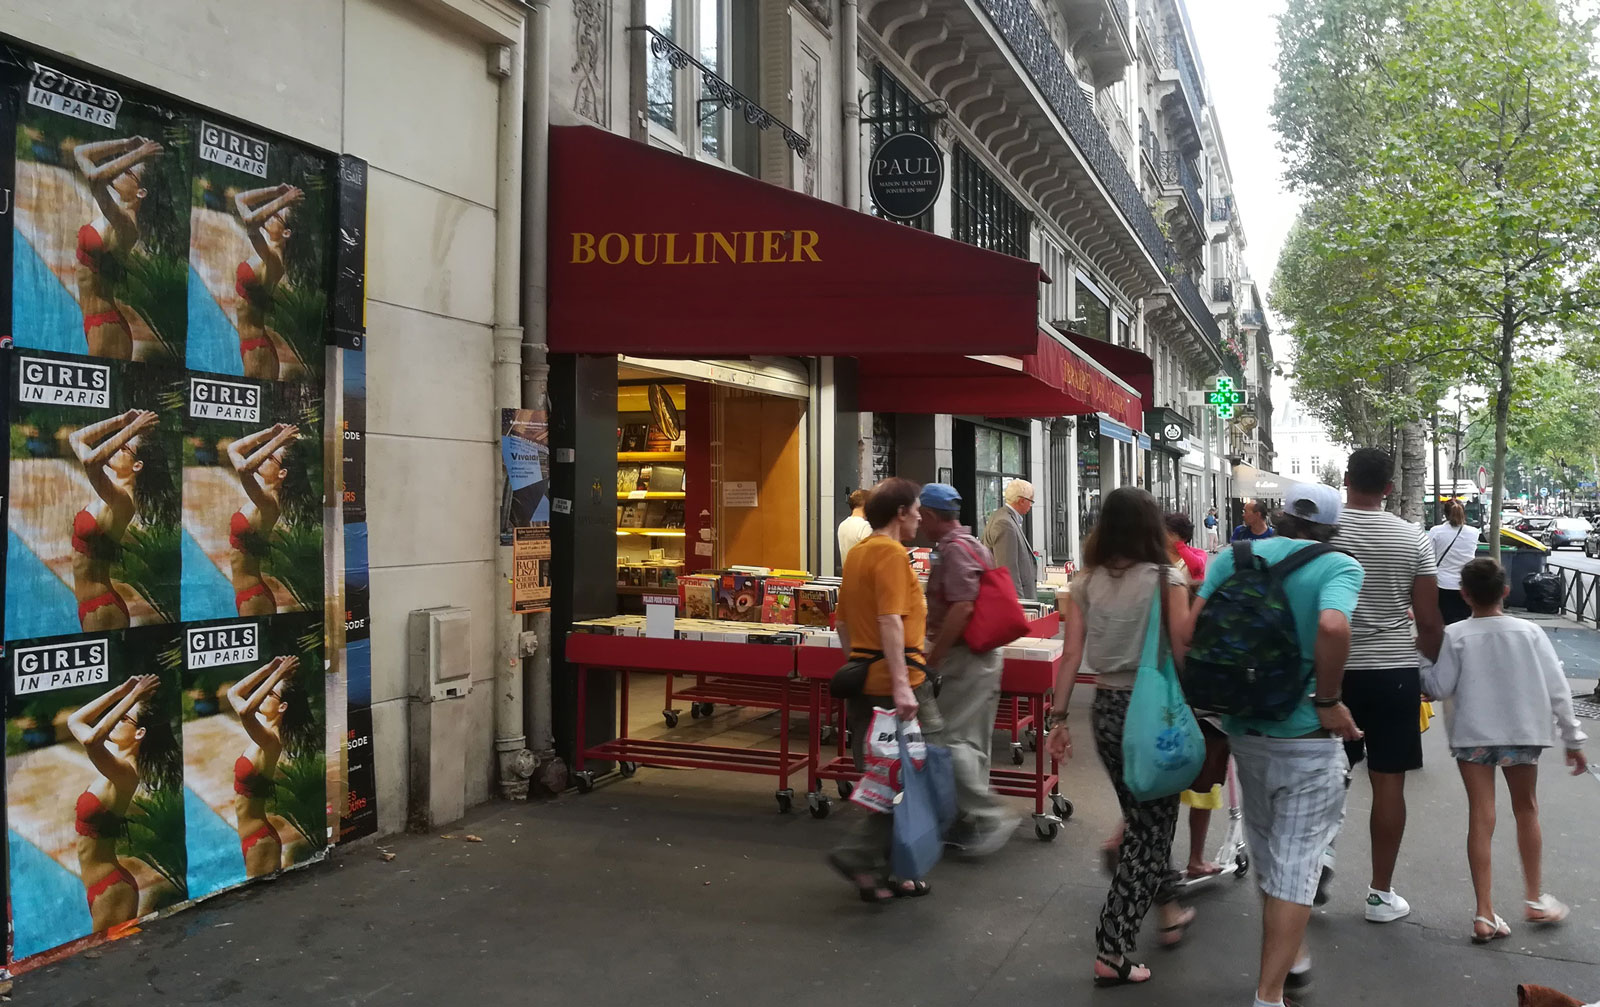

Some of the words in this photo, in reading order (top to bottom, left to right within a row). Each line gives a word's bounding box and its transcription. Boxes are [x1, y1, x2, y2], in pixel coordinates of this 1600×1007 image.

[39, 70, 117, 108] GIRLS
[33, 90, 52, 106] IN
[62, 99, 112, 124] PARIS
[205, 128, 264, 160] GIRLS
[203, 147, 218, 160] IN
[225, 154, 264, 175] PARIS
[875, 157, 938, 176] PAUL
[568, 229, 822, 265] BOULINIER
[27, 364, 105, 389] GIRLS
[25, 387, 43, 399] IN
[54, 390, 105, 405] PARIS
[195, 384, 256, 406] GIRLS
[1210, 393, 1239, 403] 26°C
[194, 404, 208, 415] IN
[216, 406, 256, 420] PARIS
[192, 629, 253, 651] GIRLS
[21, 646, 102, 673] GIRLS
[192, 654, 206, 666] IN
[214, 648, 254, 663] PARIS
[20, 677, 39, 691] IN
[51, 668, 103, 687] PARIS
